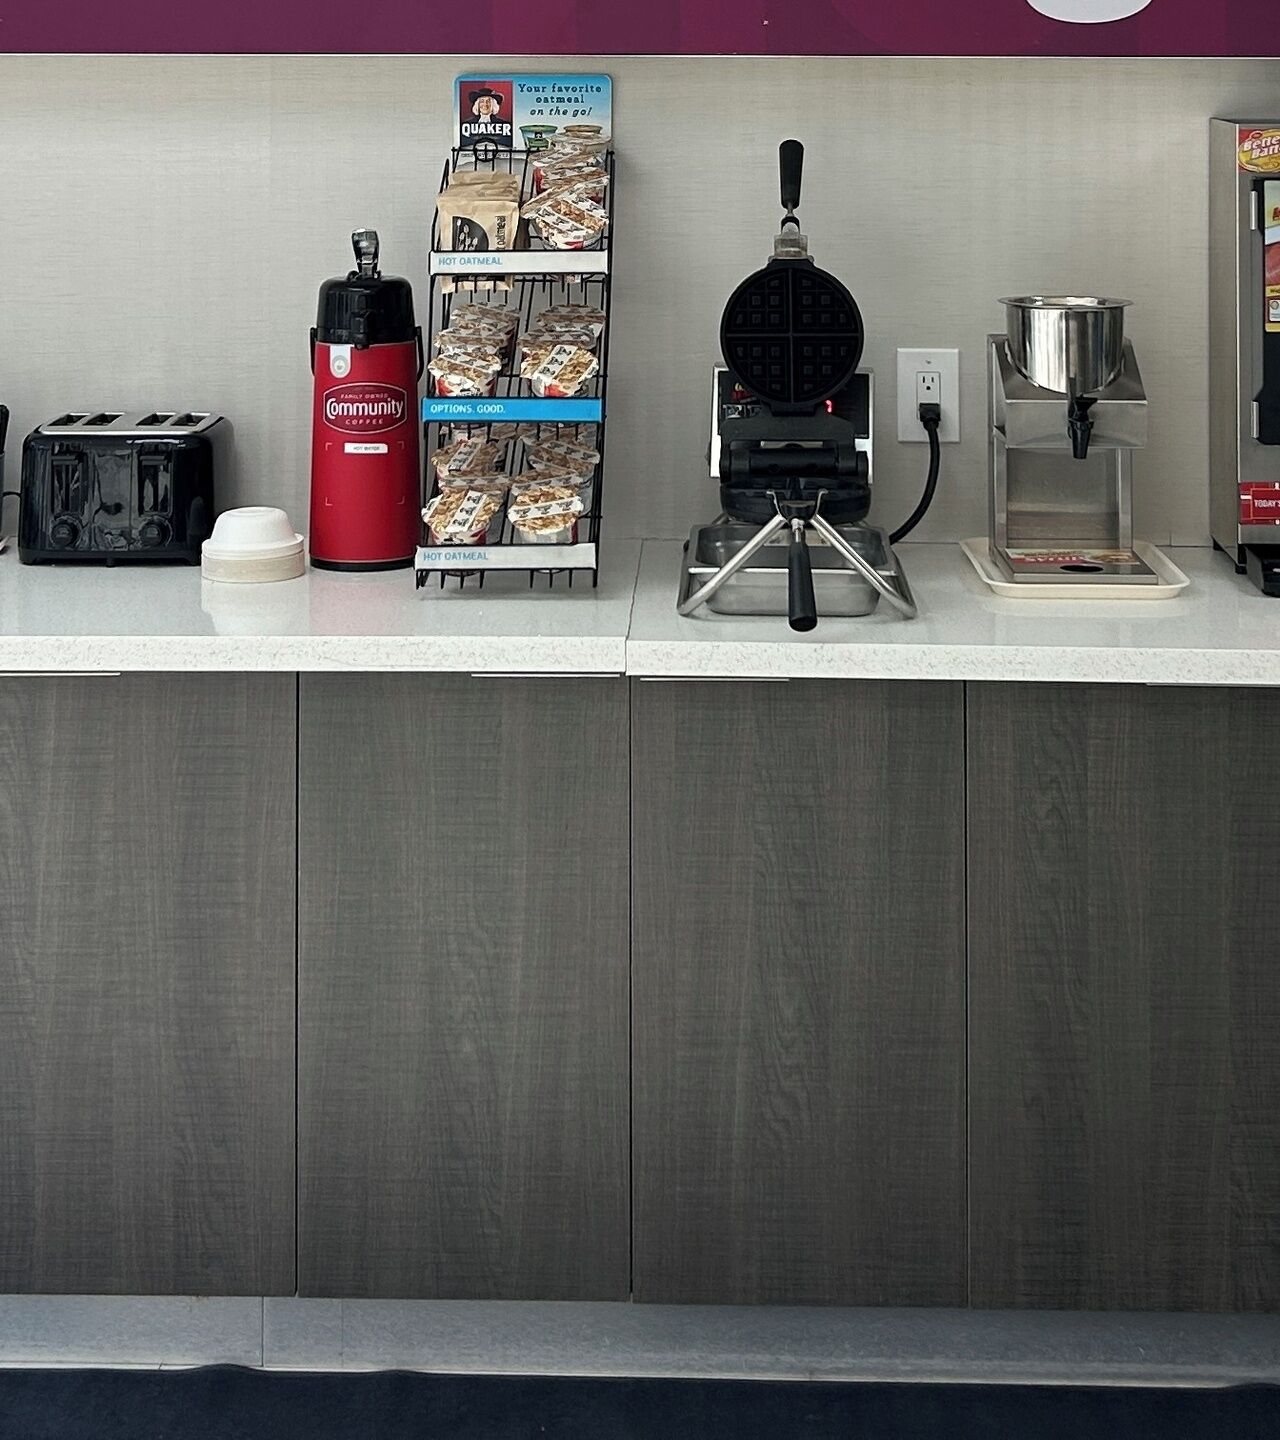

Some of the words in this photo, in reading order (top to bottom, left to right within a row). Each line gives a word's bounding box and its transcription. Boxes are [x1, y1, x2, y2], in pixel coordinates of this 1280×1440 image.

[518, 83, 546, 93] Your
[552, 83, 602, 93] favorite
[535, 94, 585, 104] oatmeal
[530, 108, 544, 116] on
[549, 106, 568, 116] the
[572, 107, 592, 117] go!
[462, 123, 511, 137] QUAKER
[438, 257, 457, 266] HOT
[459, 256, 503, 265] OATMEAL
[327, 398, 404, 419] Community
[477, 404, 506, 413] GOOD.
[423, 552, 442, 561] HOT
[444, 552, 488, 561] OATMEAL
